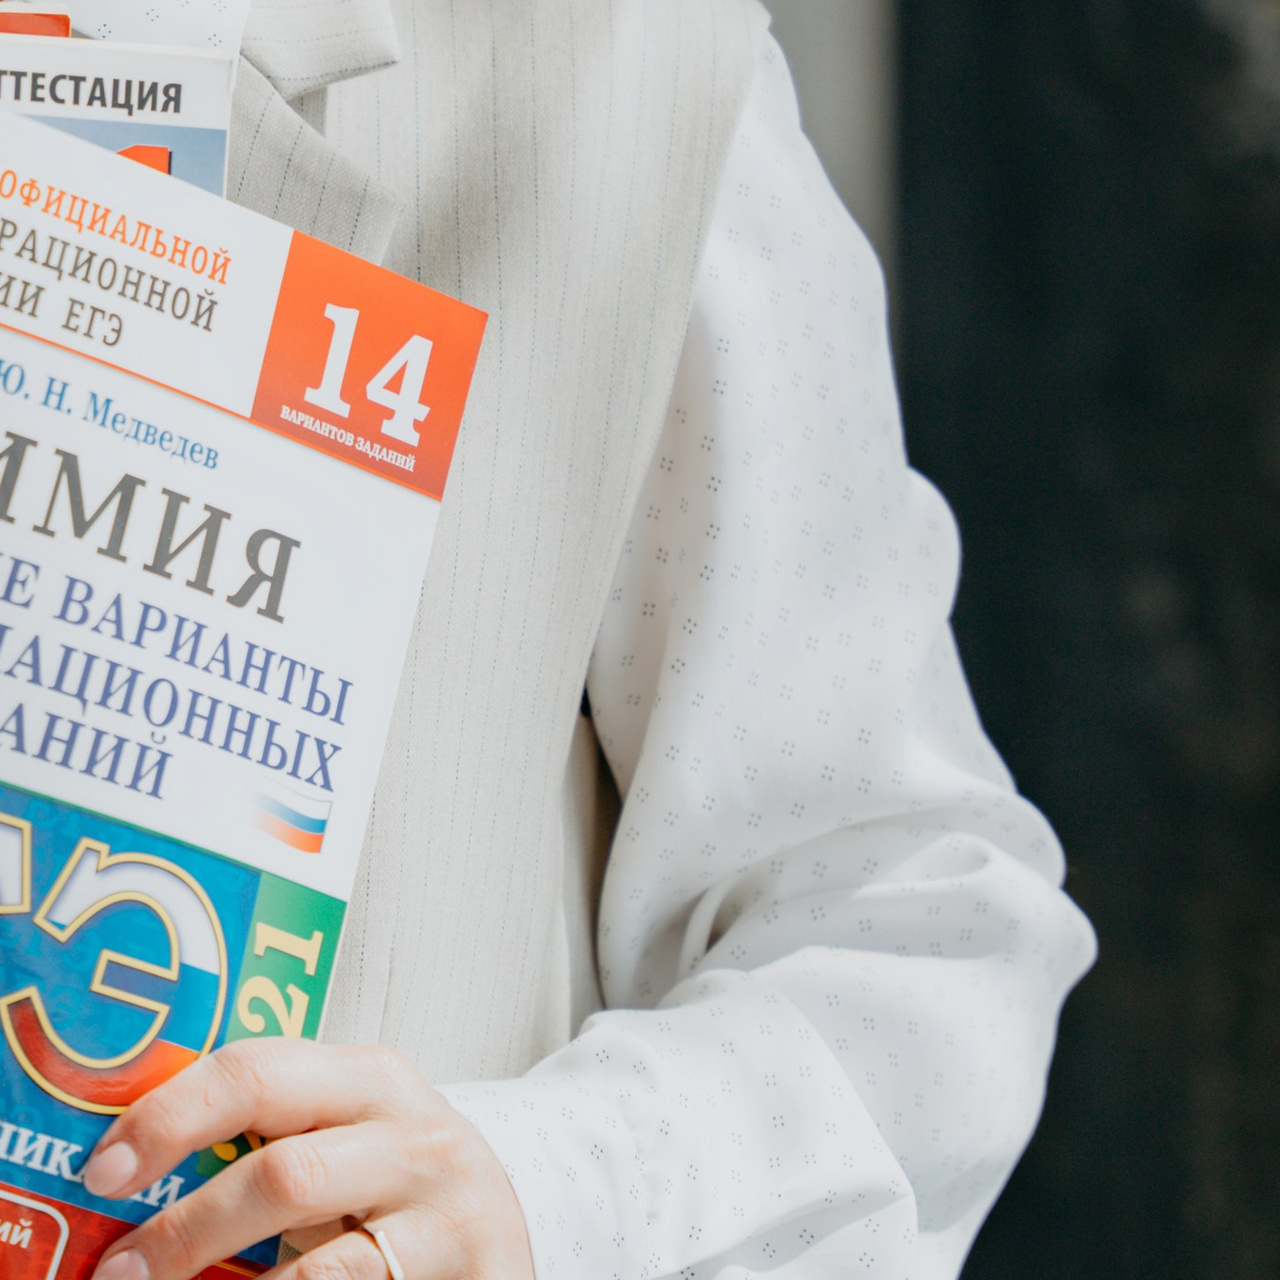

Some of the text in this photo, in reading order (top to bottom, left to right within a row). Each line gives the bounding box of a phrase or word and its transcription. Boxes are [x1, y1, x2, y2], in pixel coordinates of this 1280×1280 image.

[61, 297, 124, 348] ЕГЭ
[303, 302, 434, 447] 14
[40, 377, 73, 415] Н.
[82, 396, 220, 470] Медведев
[280, 405, 416, 473] ВАРИАНТОВ ЗАДАНИЙ
[53, 574, 354, 726] ВАРИАНТЫ
